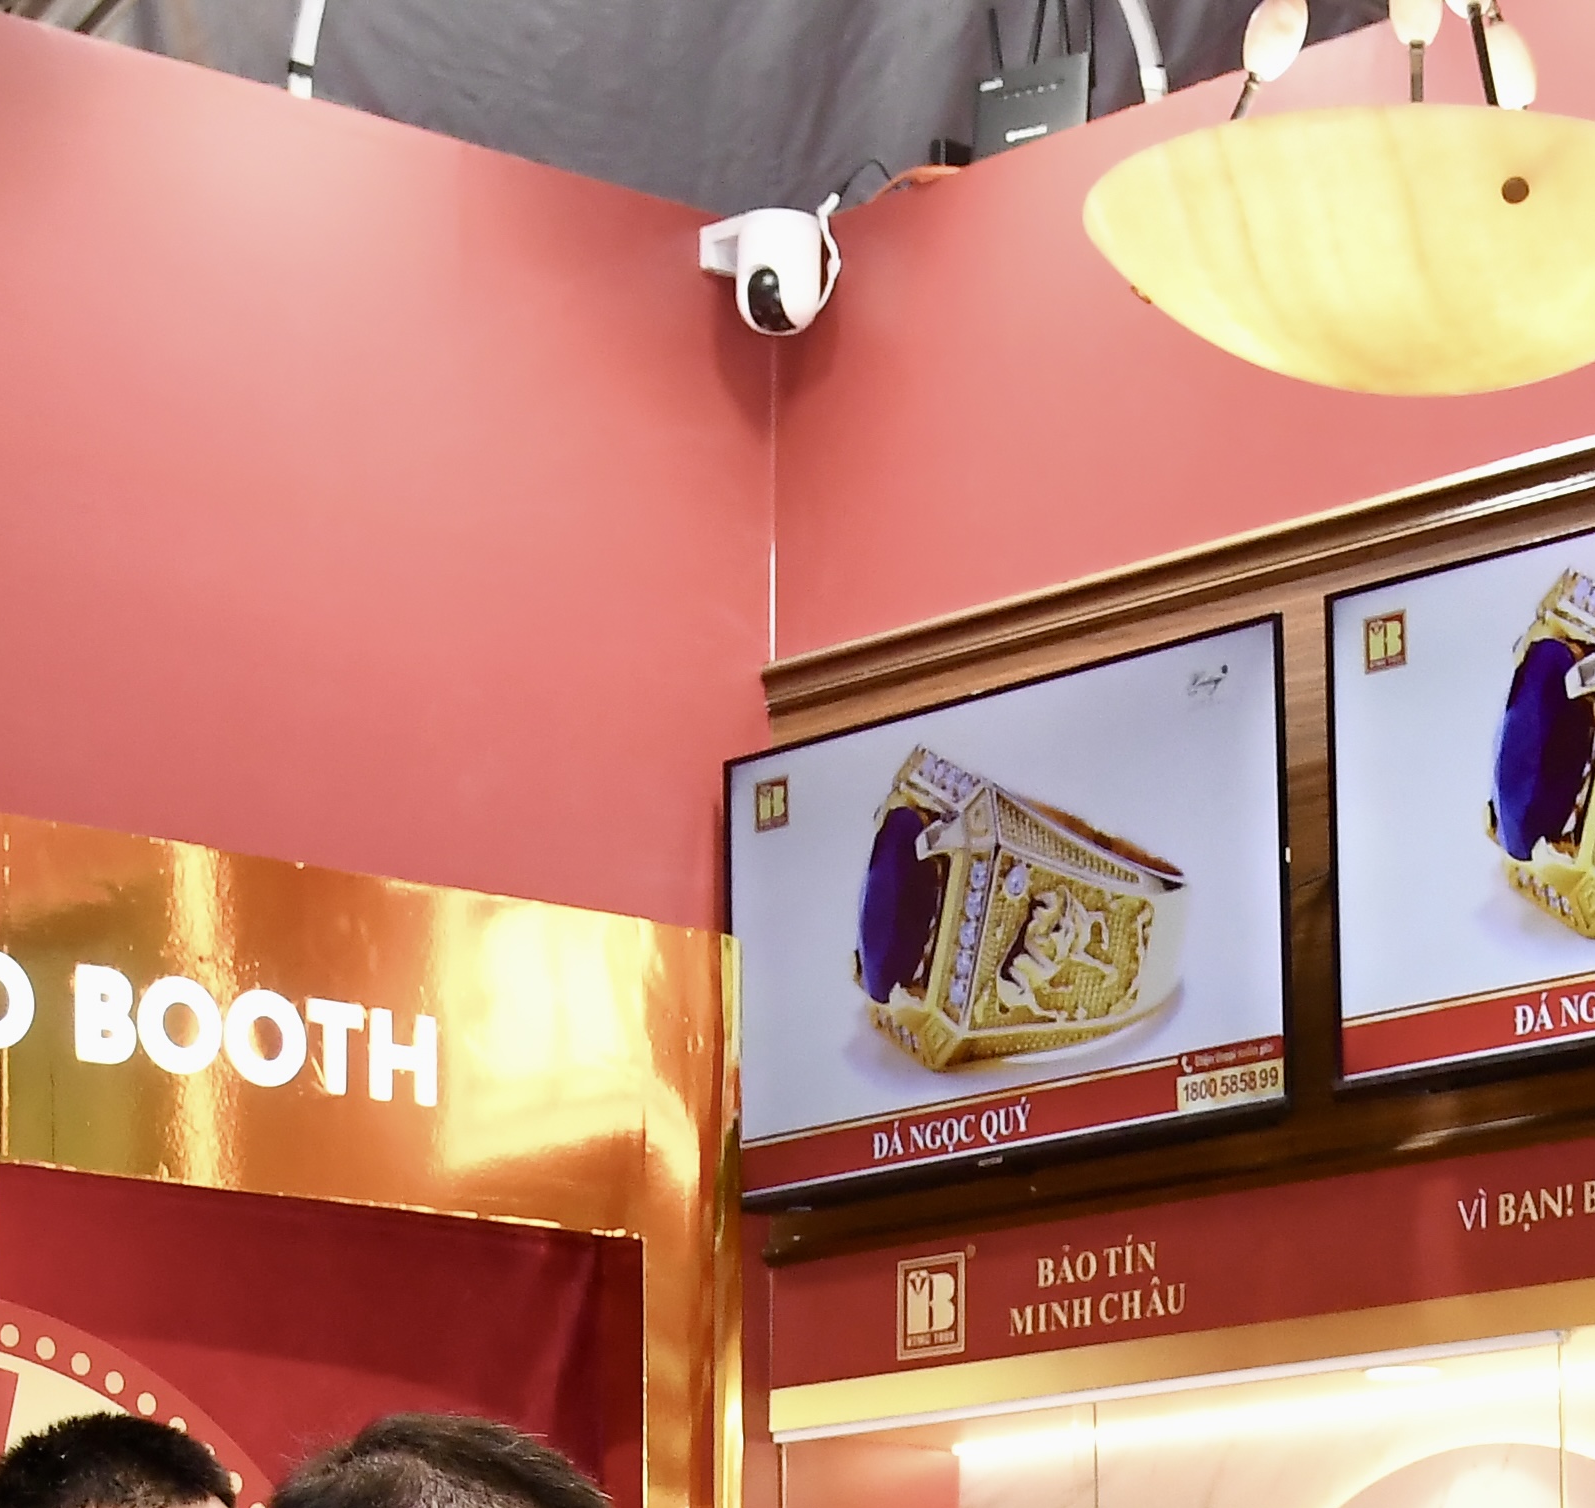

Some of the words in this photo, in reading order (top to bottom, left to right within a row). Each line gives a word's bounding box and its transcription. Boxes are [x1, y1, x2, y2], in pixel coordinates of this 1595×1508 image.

[73, 962, 440, 1107] BOOTH
[1513, 991, 1555, 1036] ĐÁ
[1183, 1077, 1217, 1103] 1800
[873, 1119, 903, 1161] ĐÁ
[909, 1112, 975, 1153] NGỌC
[980, 1096, 1032, 1143] QUÝ
[1457, 1188, 1487, 1232] VÌ
[1498, 1184, 1574, 1232] BẠN!
[1037, 1244, 1098, 1289] BẢO
[1103, 1233, 1157, 1277] TÍN
[1009, 1296, 1093, 1337] MINH
[1098, 1275, 1186, 1324] CHÂU
